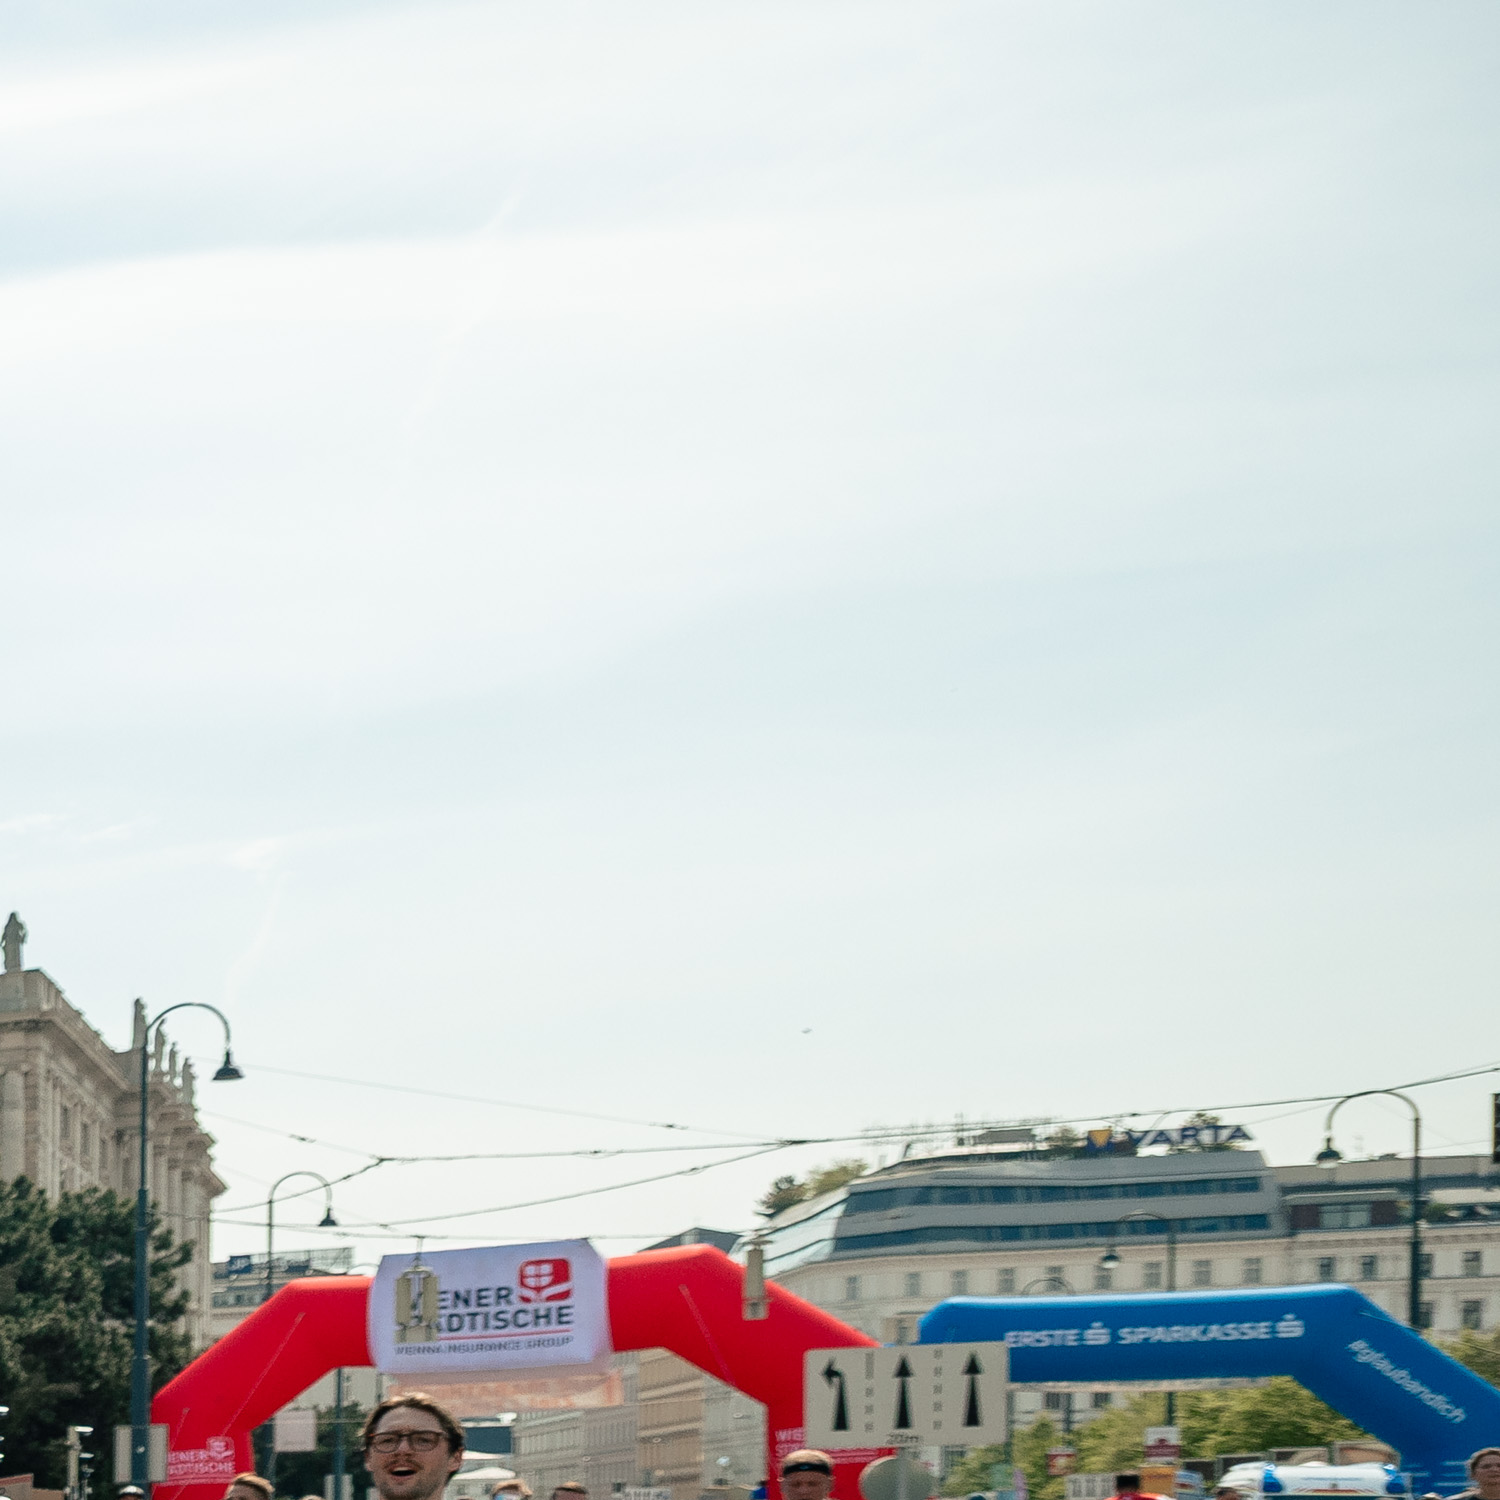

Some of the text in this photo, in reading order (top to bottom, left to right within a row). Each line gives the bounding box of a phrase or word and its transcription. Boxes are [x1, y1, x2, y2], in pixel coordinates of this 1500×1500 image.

[1127, 1124, 1252, 1146] VARTA
[411, 1286, 513, 1310] ENER
[411, 1305, 575, 1333] DTISCHE
